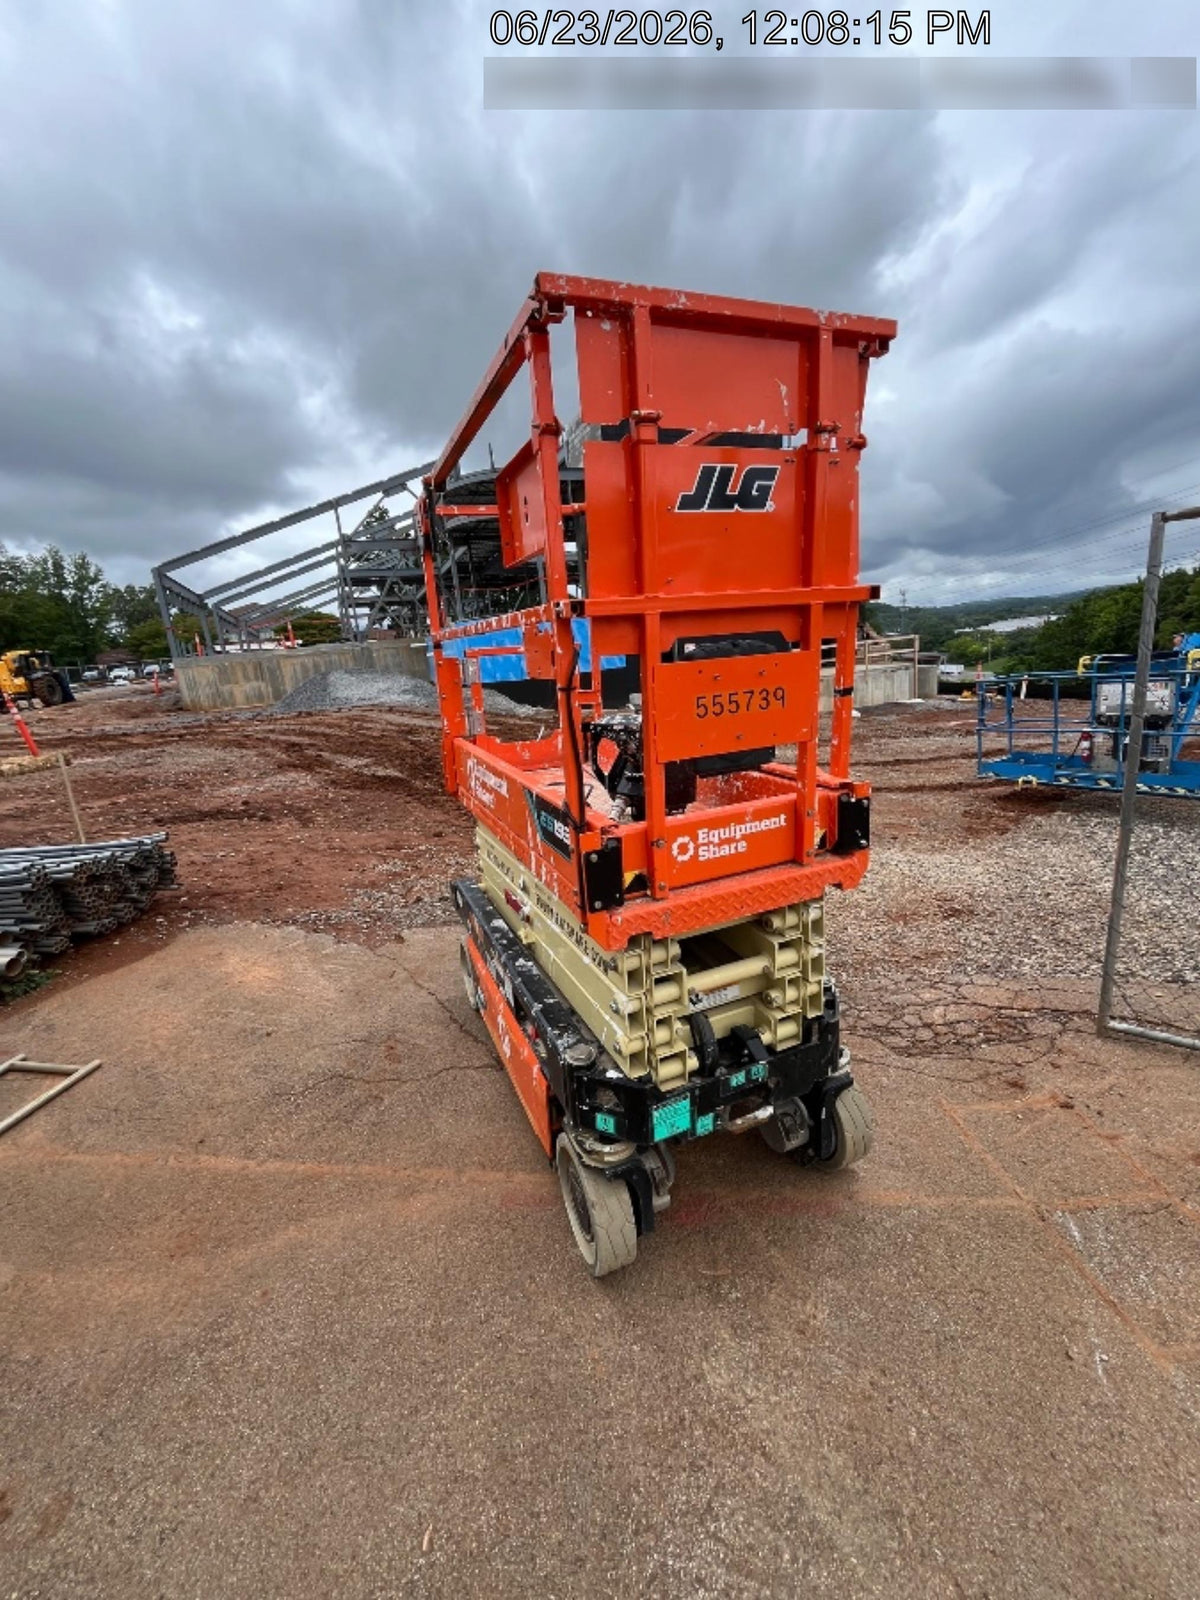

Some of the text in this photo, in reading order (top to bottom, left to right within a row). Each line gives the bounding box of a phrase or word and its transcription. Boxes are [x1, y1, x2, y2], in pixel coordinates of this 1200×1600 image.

[674, 463, 781, 512] JLG
[695, 685, 786, 720] 555739
[539, 809, 571, 846] ES193
[697, 813, 787, 844] Equipment
[698, 840, 748, 861] Share
